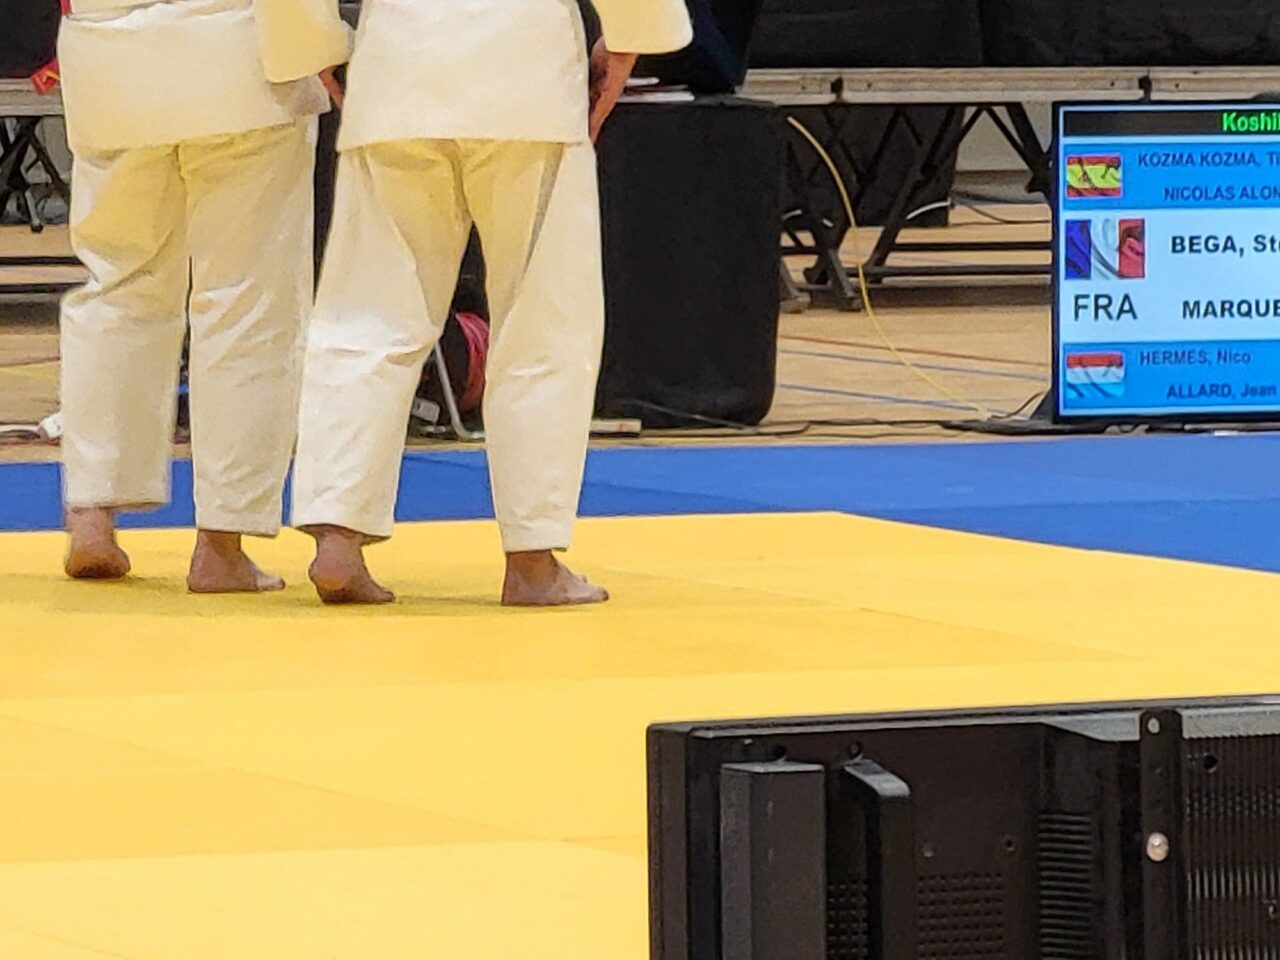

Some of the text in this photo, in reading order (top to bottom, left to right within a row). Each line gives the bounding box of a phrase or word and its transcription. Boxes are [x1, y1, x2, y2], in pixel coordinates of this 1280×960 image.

[1222, 111, 1280, 132] Koshi
[1138, 152, 1196, 168] KOZMA
[1199, 150, 1261, 168] KOZMA,
[1164, 186, 1235, 201] NICOLAS
[1171, 233, 1280, 258] BEGA, St
[1073, 293, 1139, 322] FRA
[1139, 349, 1251, 366] HERMES, Nico
[1166, 384, 1277, 400] ALLARD, Jean
